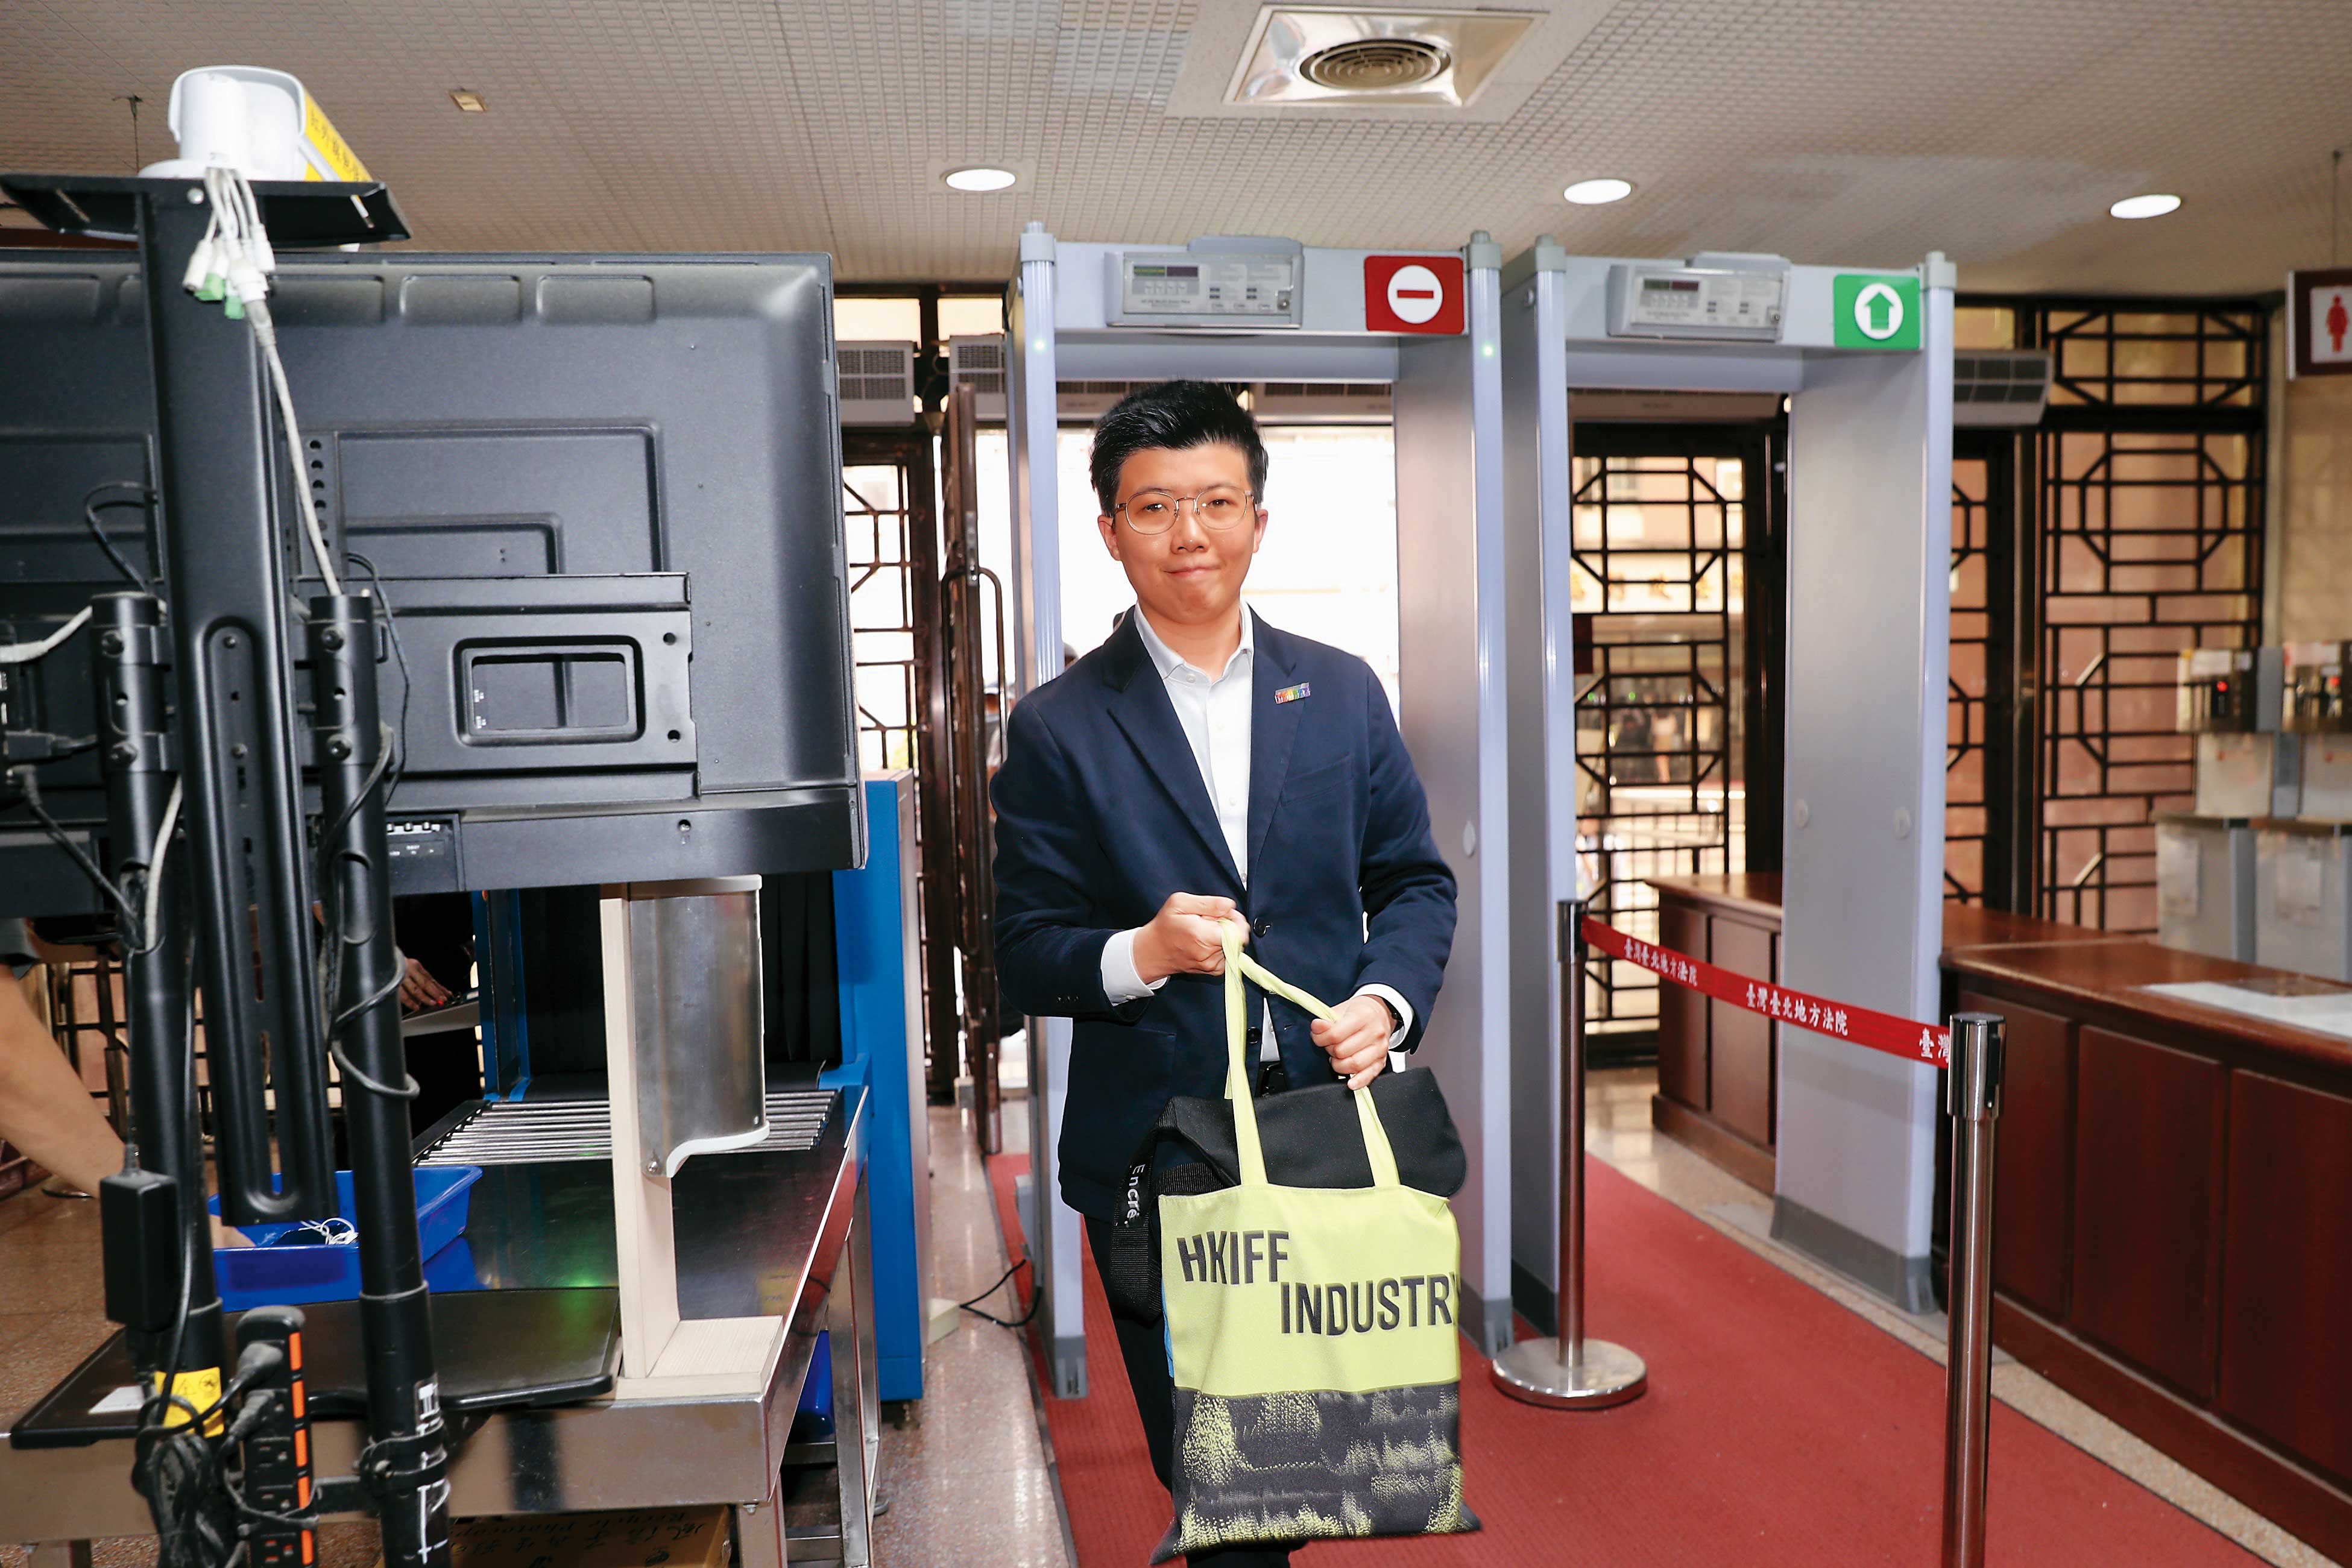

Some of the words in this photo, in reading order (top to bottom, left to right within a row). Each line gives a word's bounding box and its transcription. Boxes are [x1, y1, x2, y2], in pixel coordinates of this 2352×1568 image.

[1746, 982, 1848, 1036] 臺灣臺北地方法院
[1176, 1230, 1289, 1285] HKIFF
